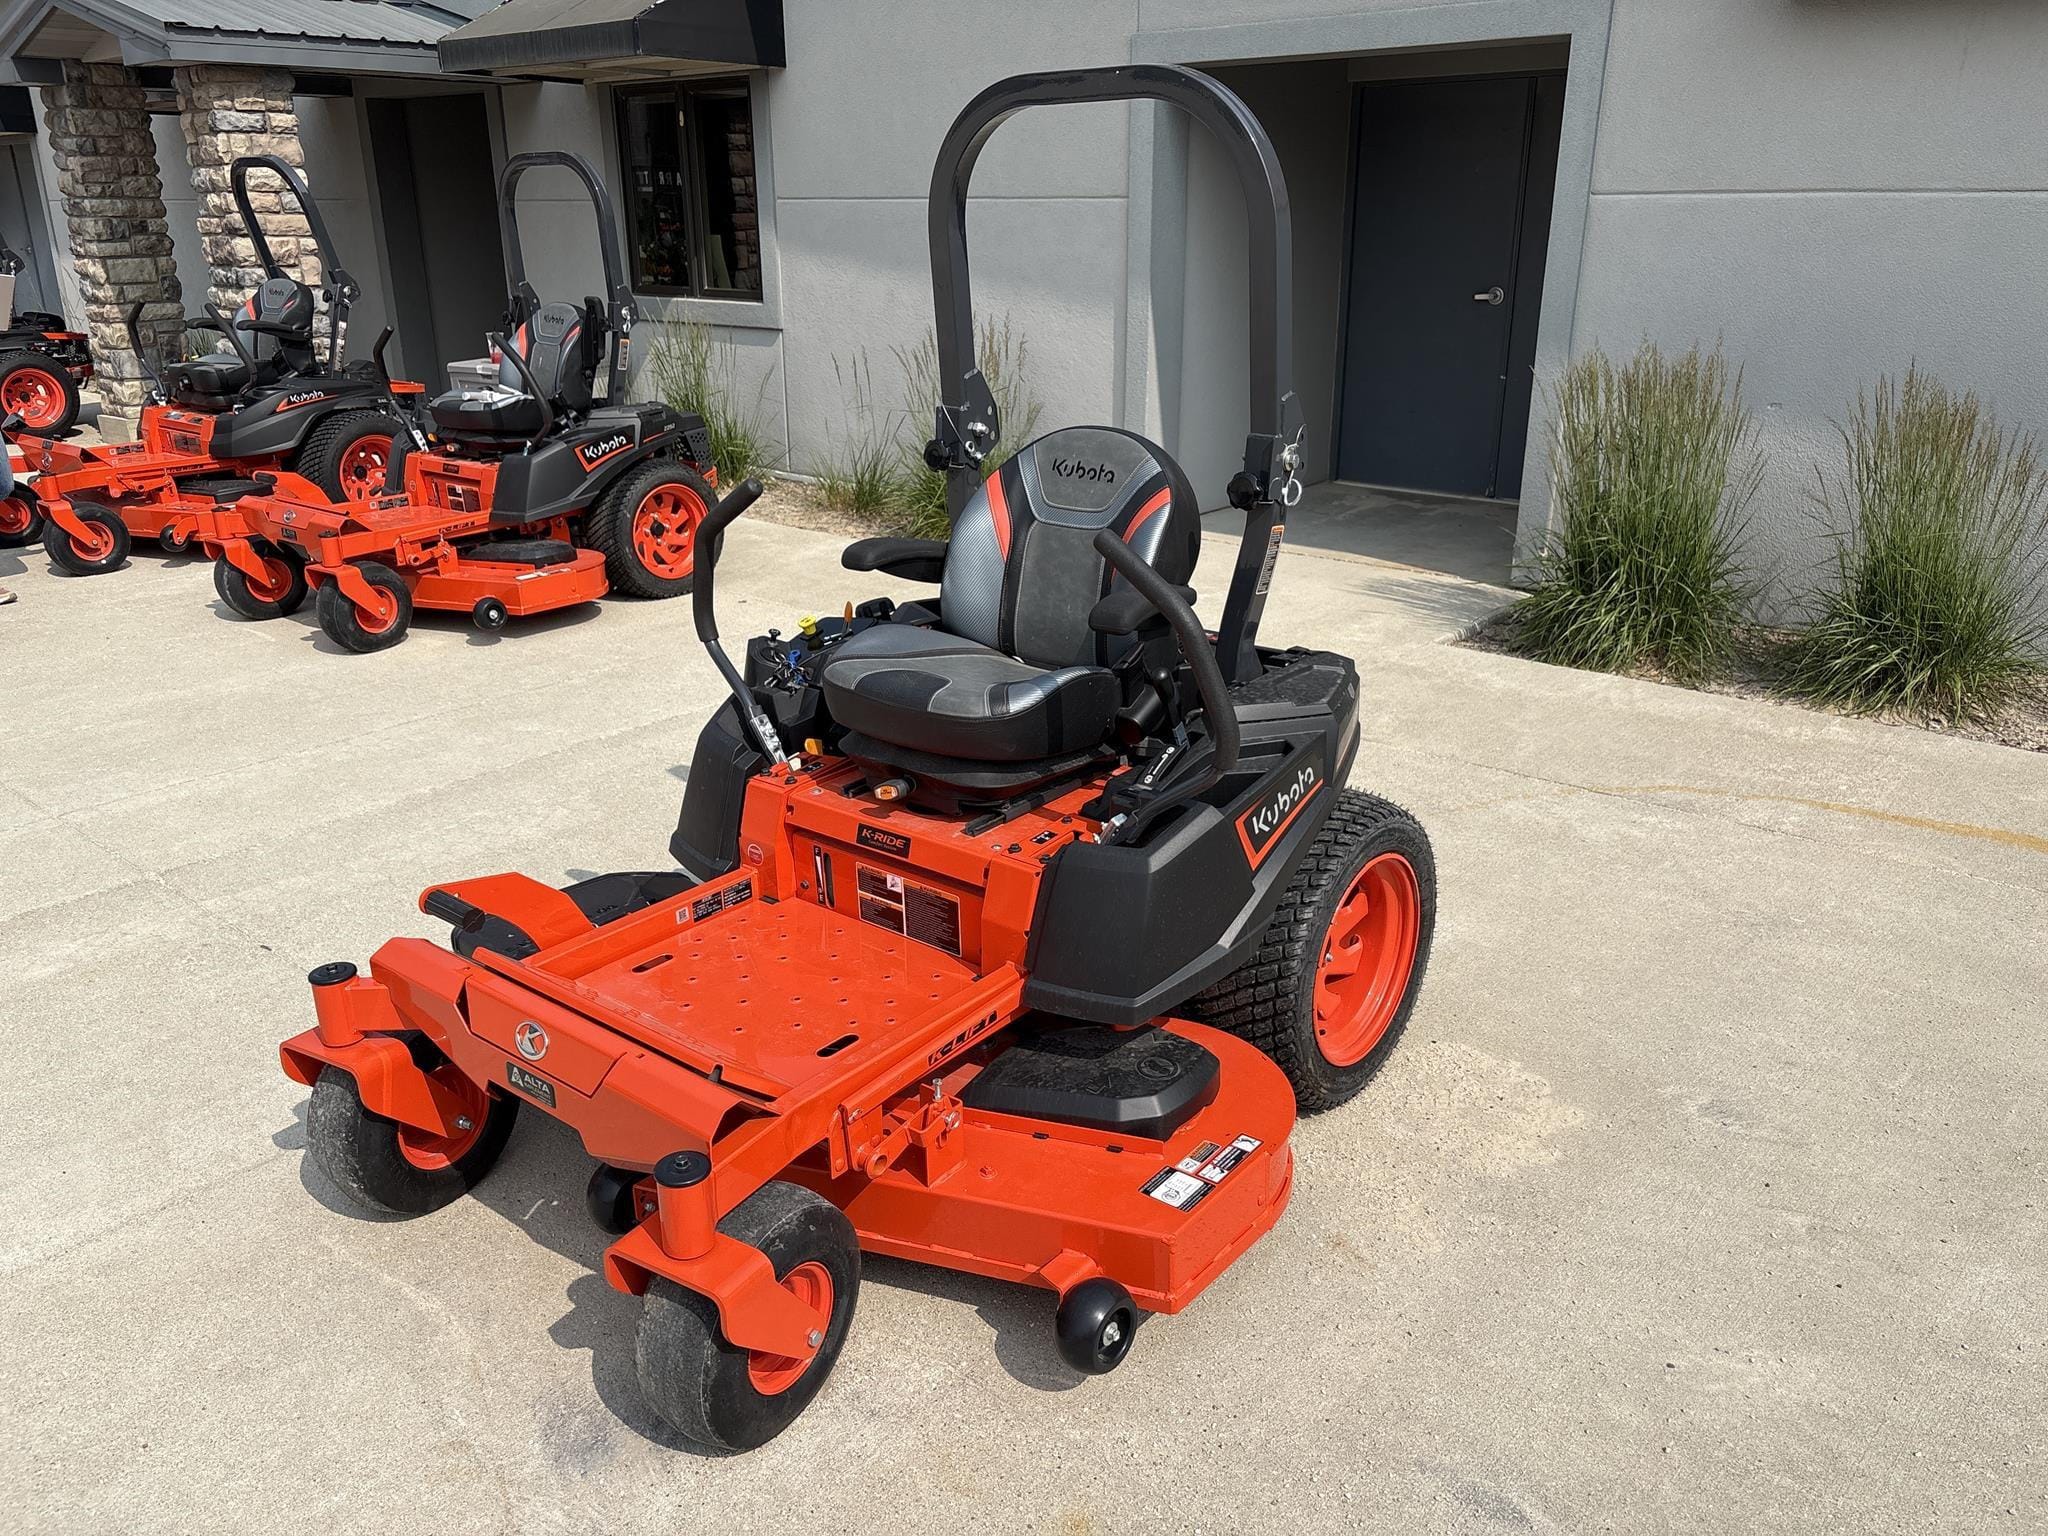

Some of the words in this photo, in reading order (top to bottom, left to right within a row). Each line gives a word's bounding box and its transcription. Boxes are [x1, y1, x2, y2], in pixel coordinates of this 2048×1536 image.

[289, 390, 325, 403] Kubota
[583, 434, 627, 459] Kubota
[1051, 458, 1116, 484] Kubota
[1252, 766, 1315, 835] Kubota
[861, 828, 906, 849] K-RIDE
[928, 1010, 998, 1067] K-LIFT
[524, 1073, 551, 1095] ALTA
